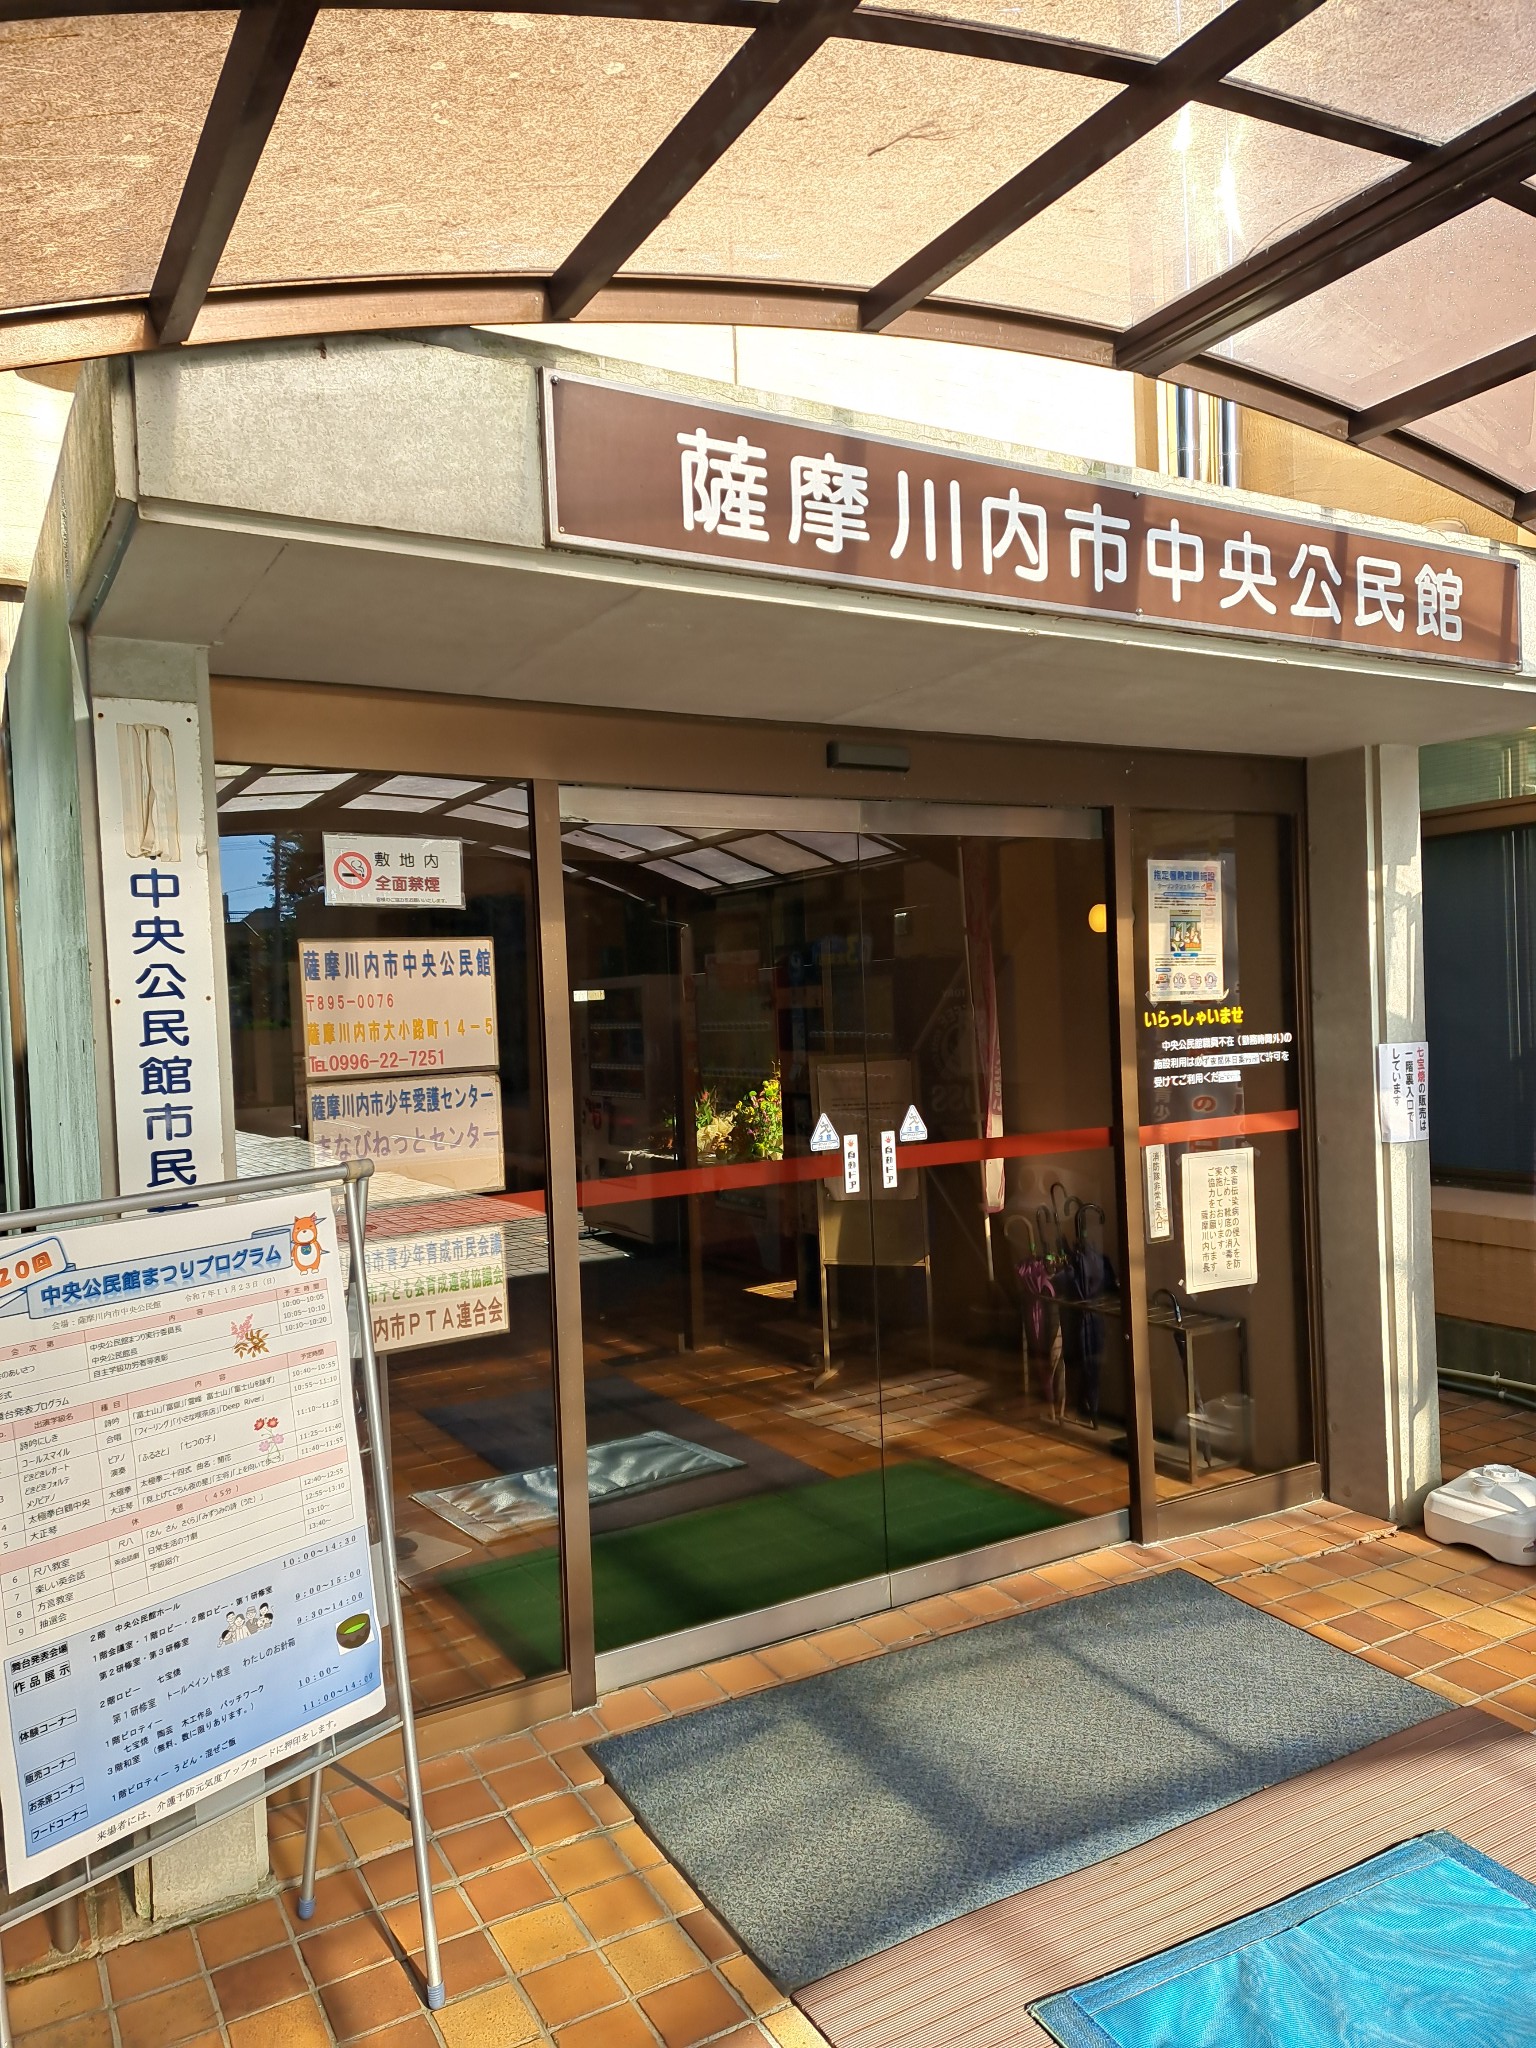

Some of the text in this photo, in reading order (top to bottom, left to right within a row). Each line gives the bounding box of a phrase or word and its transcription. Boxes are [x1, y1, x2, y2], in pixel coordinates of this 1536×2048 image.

[677, 427, 1464, 642] 薩摩川内市中央公民館
[374, 852, 439, 869] 敷地内
[375, 875, 440, 892] 全面禁煙
[303, 948, 491, 981] 薩摩川内市中央公民館
[1144, 1007, 1243, 1028] いらっしゃいませ
[130, 868, 199, 1213] 中央公民館市民
[1392, 1048, 1401, 1106] しています
[1405, 1051, 1414, 1122] 一階裏入口で
[1417, 1047, 1426, 1131] 七宝焼の販売は
[311, 1084, 493, 1120] 薩摩川内市少年愛護センター
[848, 1151, 856, 1189] 自動ドア
[885, 1146, 894, 1184] 自動ドア
[1208, 1167, 1218, 1277] ご協力をお願いします。
[1215, 1166, 1225, 1255] 実施しております。
[1231, 1165, 1241, 1269] 家畜伝染病の侵入を防
[1201, 1210, 1210, 1273] 薩摩川内市長
[40, 1244, 282, 1306] 中央公民館まつりプログラム
[90, 1325, 182, 1351] 中央公民館まつり実行委員長
[92, 1348, 138, 1365] 中央公民館長
[0, 1366, 35, 1379] のあいさつ
[20, 1434, 58, 1450] 詩吟にしき
[137, 1434, 216, 1463] 「ふるさと」 「七つの子」
[22, 1448, 70, 1468] コールスマイル
[23, 1463, 70, 1482] どきどきレガート
[108, 1454, 125, 1464] ピアノ
[25, 1476, 70, 1495] どきどきフォルテ
[108, 1485, 132, 1499] 太極拳
[110, 1501, 134, 1515] 大正琴
[3, 1541, 9, 1549] 5
[30, 1525, 58, 1541] 大正琴
[148, 1532, 198, 1555] 日常生活の寸劇
[33, 1558, 70, 1577] 尺八教室
[35, 1570, 86, 1594] 楽しい英会話
[15, 1593, 20, 1601] 7
[18, 1628, 24, 1636] 9
[39, 1612, 67, 1629] 抽選会
[90, 1602, 181, 1642] 2階 中央公民館ホール
[11, 1643, 68, 1673] 舞台発表会場
[100, 1667, 182, 1709] 2階ロビー 七宝焼
[112, 1698, 157, 1725] 第1研修室
[167, 1665, 231, 1700] トールペイント教室
[19, 1714, 77, 1742] 体験コーナー
[123, 1735, 149, 1753] 七宝焼
[181, 1707, 213, 1727] 木工作品
[220, 1684, 265, 1709] パッチワーク
[107, 1754, 141, 1776] 3階和室
[174, 1736, 237, 1774] うどん・混ぜご飯
[25, 1756, 75, 1785] 販売コーナー
[29, 1781, 84, 1812] お茶席コーナー
[32, 1808, 88, 1841] フードコーナー
